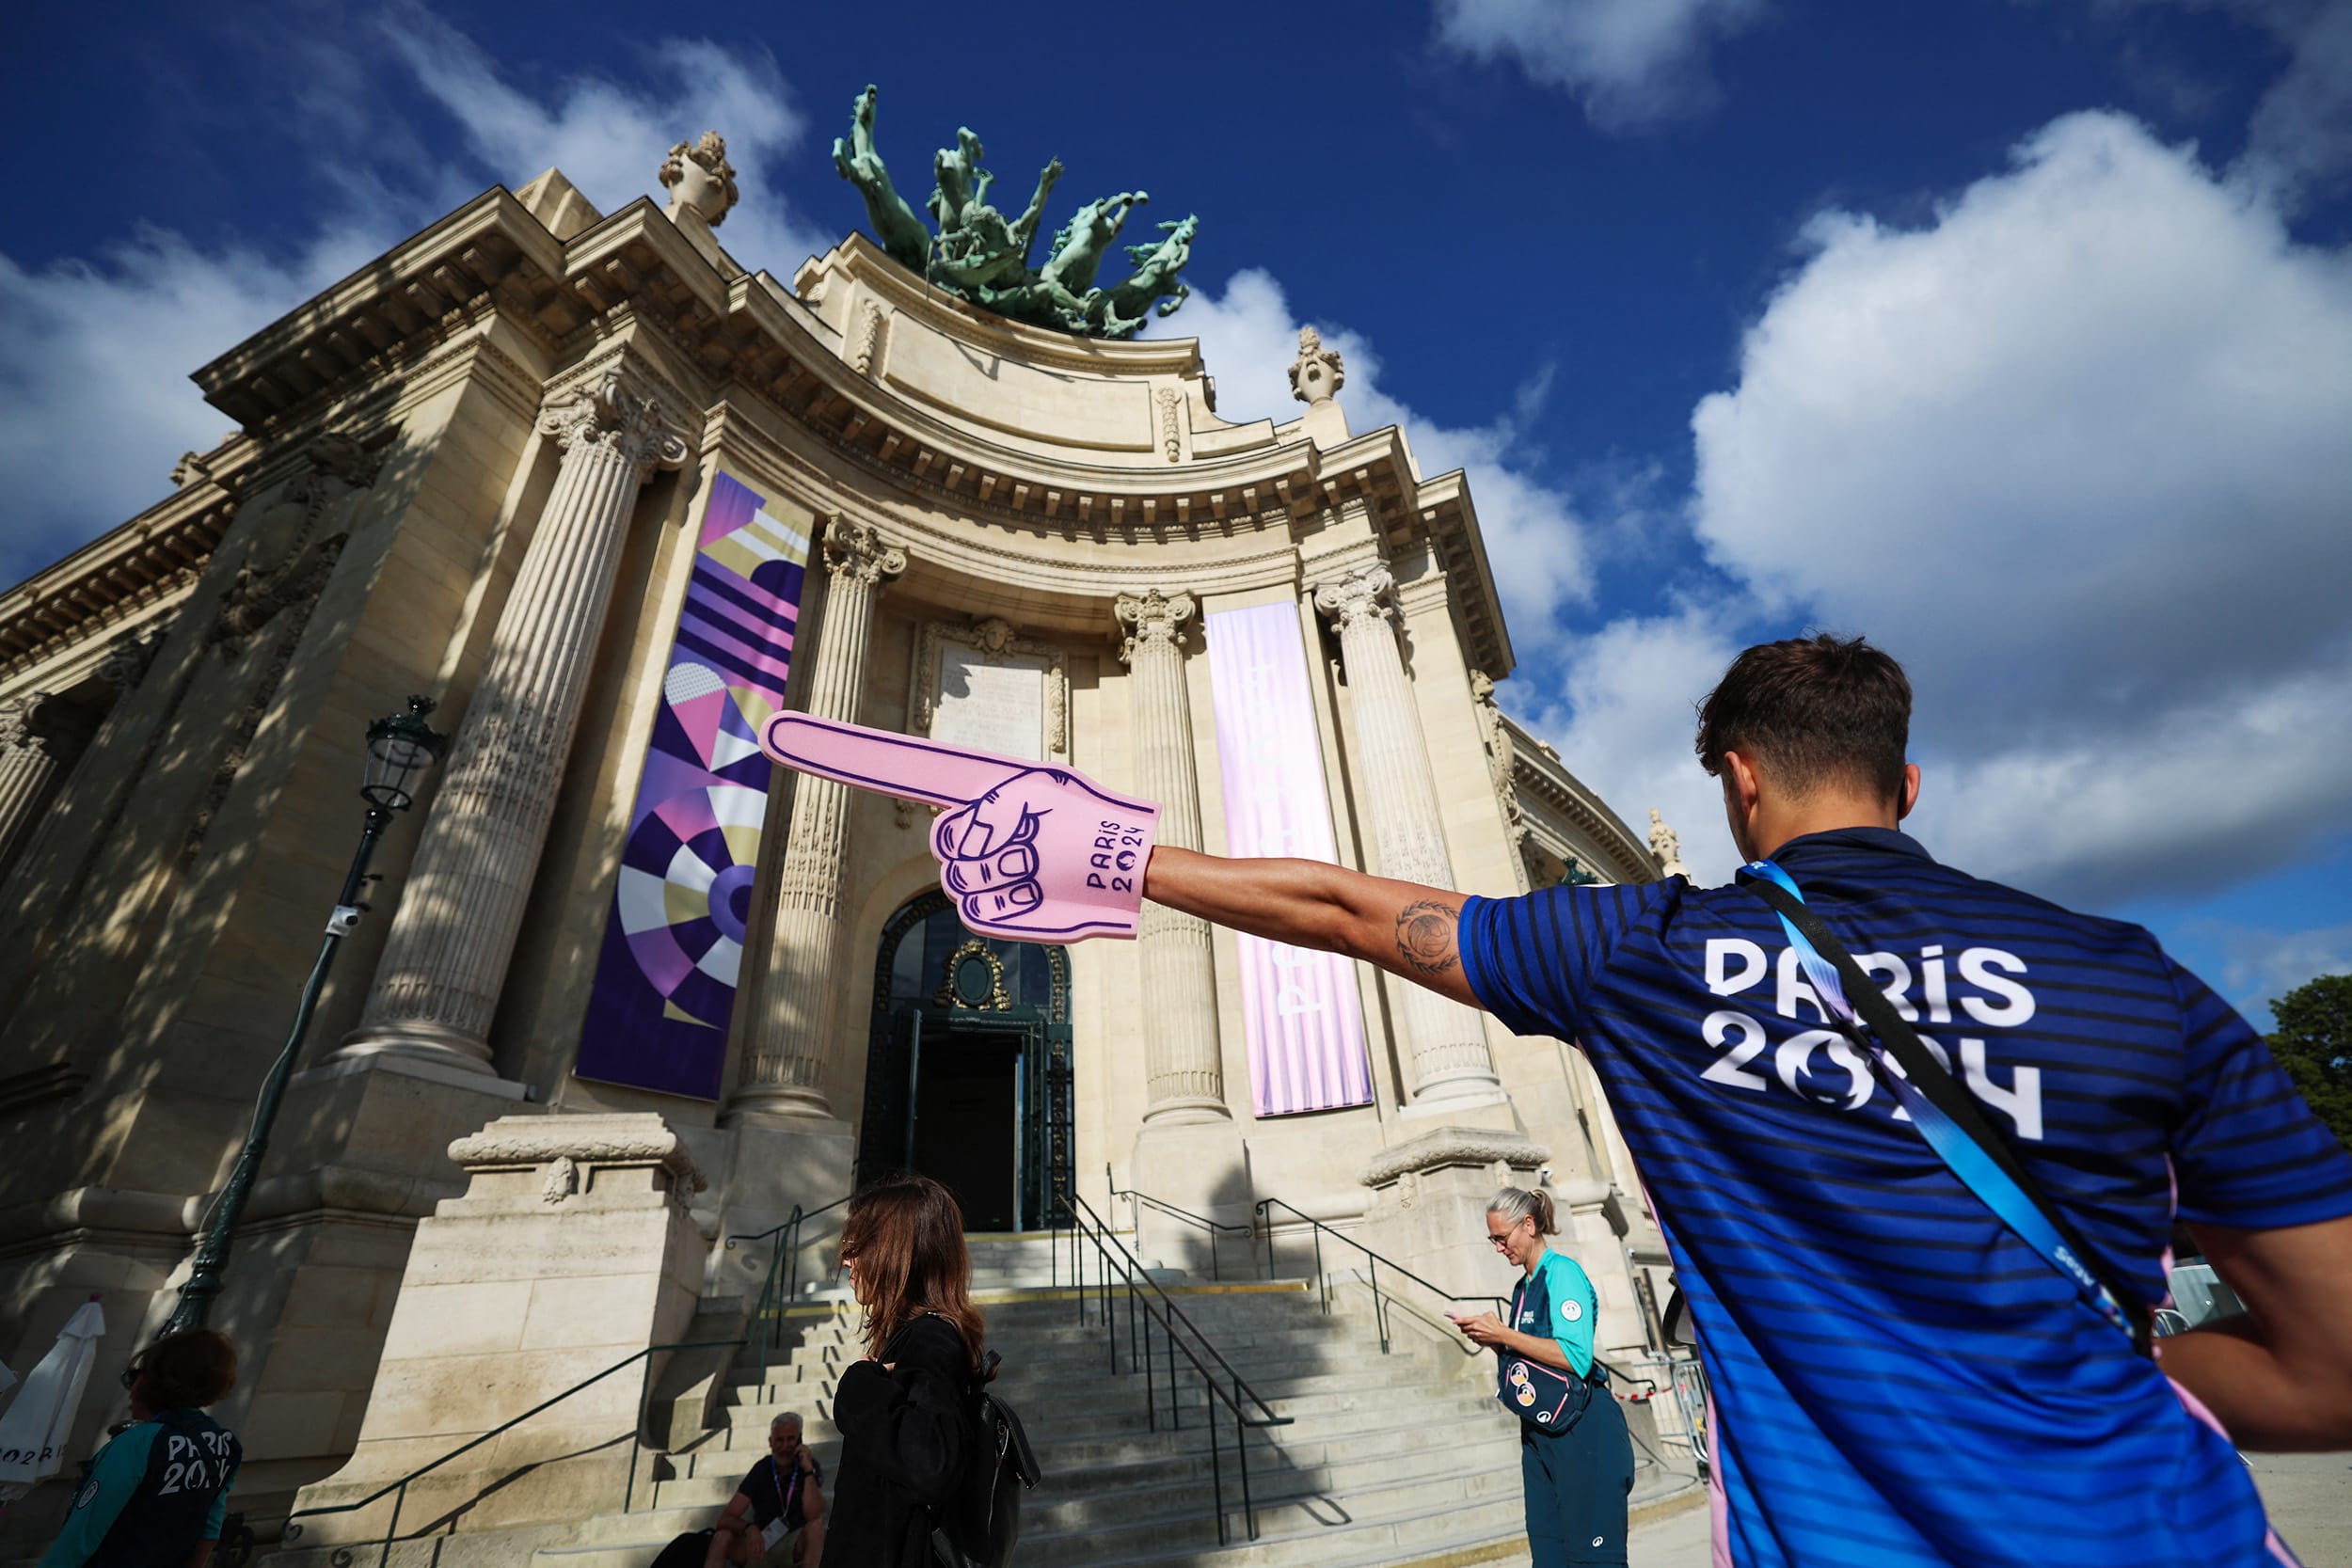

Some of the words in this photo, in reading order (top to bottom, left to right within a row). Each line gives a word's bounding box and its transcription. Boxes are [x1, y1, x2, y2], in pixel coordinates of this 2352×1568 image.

[1111, 827, 1145, 894] 2024
[1699, 1010, 2043, 1141] 204
[157, 1458, 230, 1497] 204
